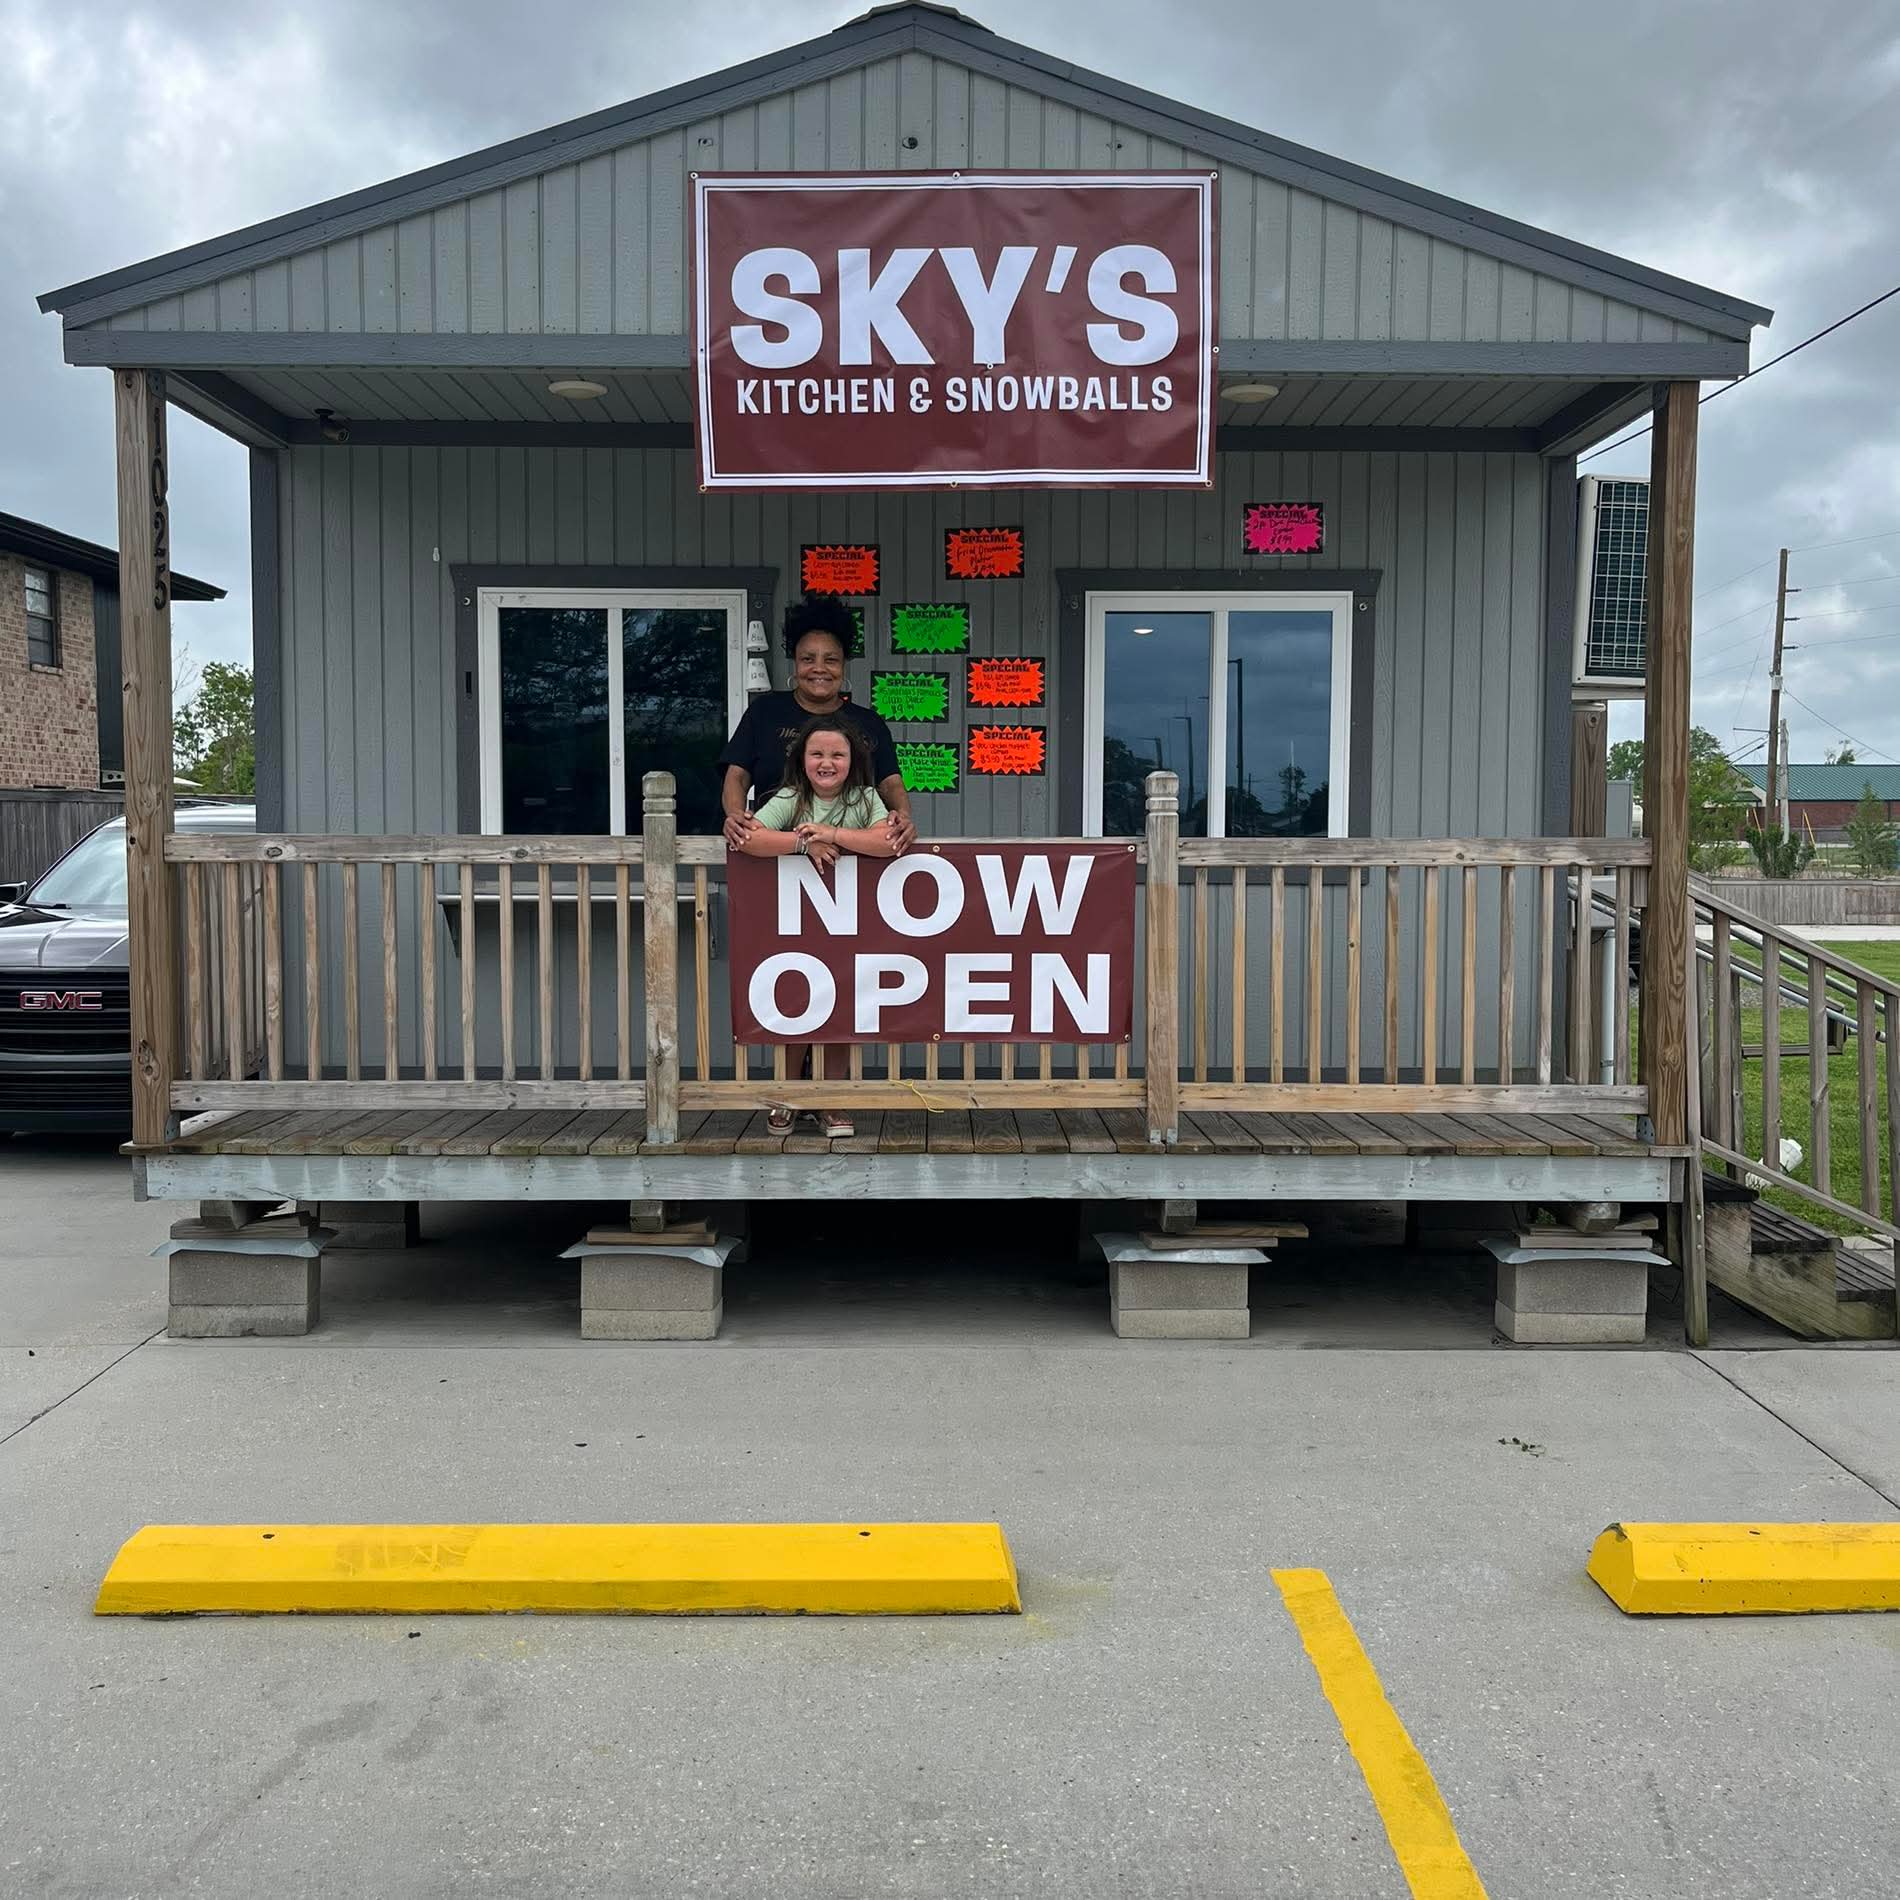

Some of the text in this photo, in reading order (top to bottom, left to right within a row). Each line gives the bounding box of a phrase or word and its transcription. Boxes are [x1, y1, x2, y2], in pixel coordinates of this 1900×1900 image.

[730, 244, 1180, 369] SKY'S
[736, 375, 1173, 415] KITCHEN & SNOWBALLS
[1259, 510, 1308, 519] SPECIAL
[959, 535, 1009, 544] SPECIAL
[815, 551, 866, 560] SPECIAL
[906, 610, 954, 619] SPECIAL
[982, 663, 1030, 672] SPECIAL
[887, 679, 935, 687] SPECIAL
[983, 731, 1031, 740] SPECIAL
[896, 749, 945, 758] SPECIAL
[777, 853, 1096, 938] NOW
[748, 951, 1111, 1036] OPEN
[20, 991, 103, 1010] GMC
